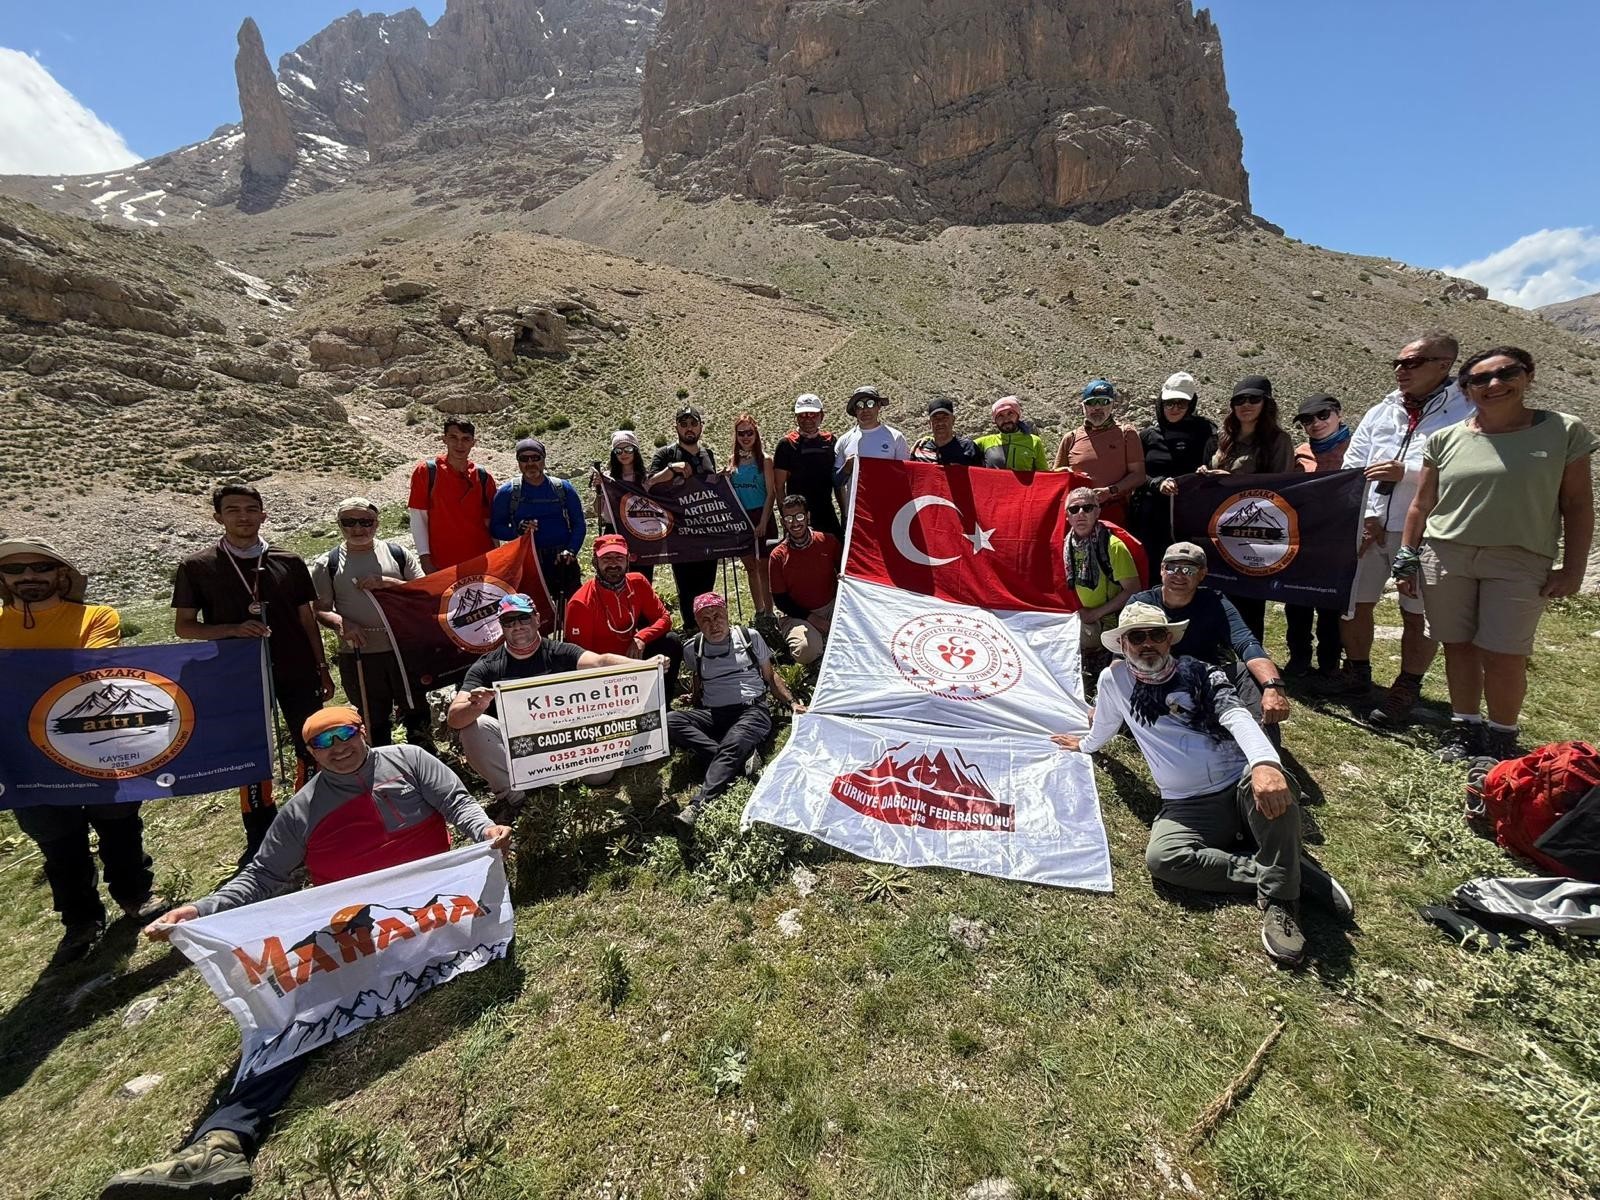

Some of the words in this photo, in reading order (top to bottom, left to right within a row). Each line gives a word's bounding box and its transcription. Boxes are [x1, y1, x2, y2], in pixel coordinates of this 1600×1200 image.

[678, 489, 719, 506] MAZAK
[684, 500, 727, 516] ARTIBİR
[79, 668, 147, 683] MAZAKA
[603, 675, 638, 684] catering
[134, 713, 146, 727] 1
[530, 707, 573, 720] Yemek
[537, 731, 572, 747] CADDE
[574, 725, 602, 741] KÖŞK
[604, 719, 637, 735] DÖNER
[98, 752, 140, 763] KAYSERİ
[549, 751, 577, 762] 0352
[580, 746, 599, 756] 336
[602, 743, 615, 751] 70
[618, 740, 631, 748] 70
[528, 744, 652, 776] www.kismetimyemek.com
[837, 780, 880, 809] TÜRKİYE
[881, 792, 927, 813] DAĞCILIK
[929, 805, 1010, 827] FEDERASYONU
